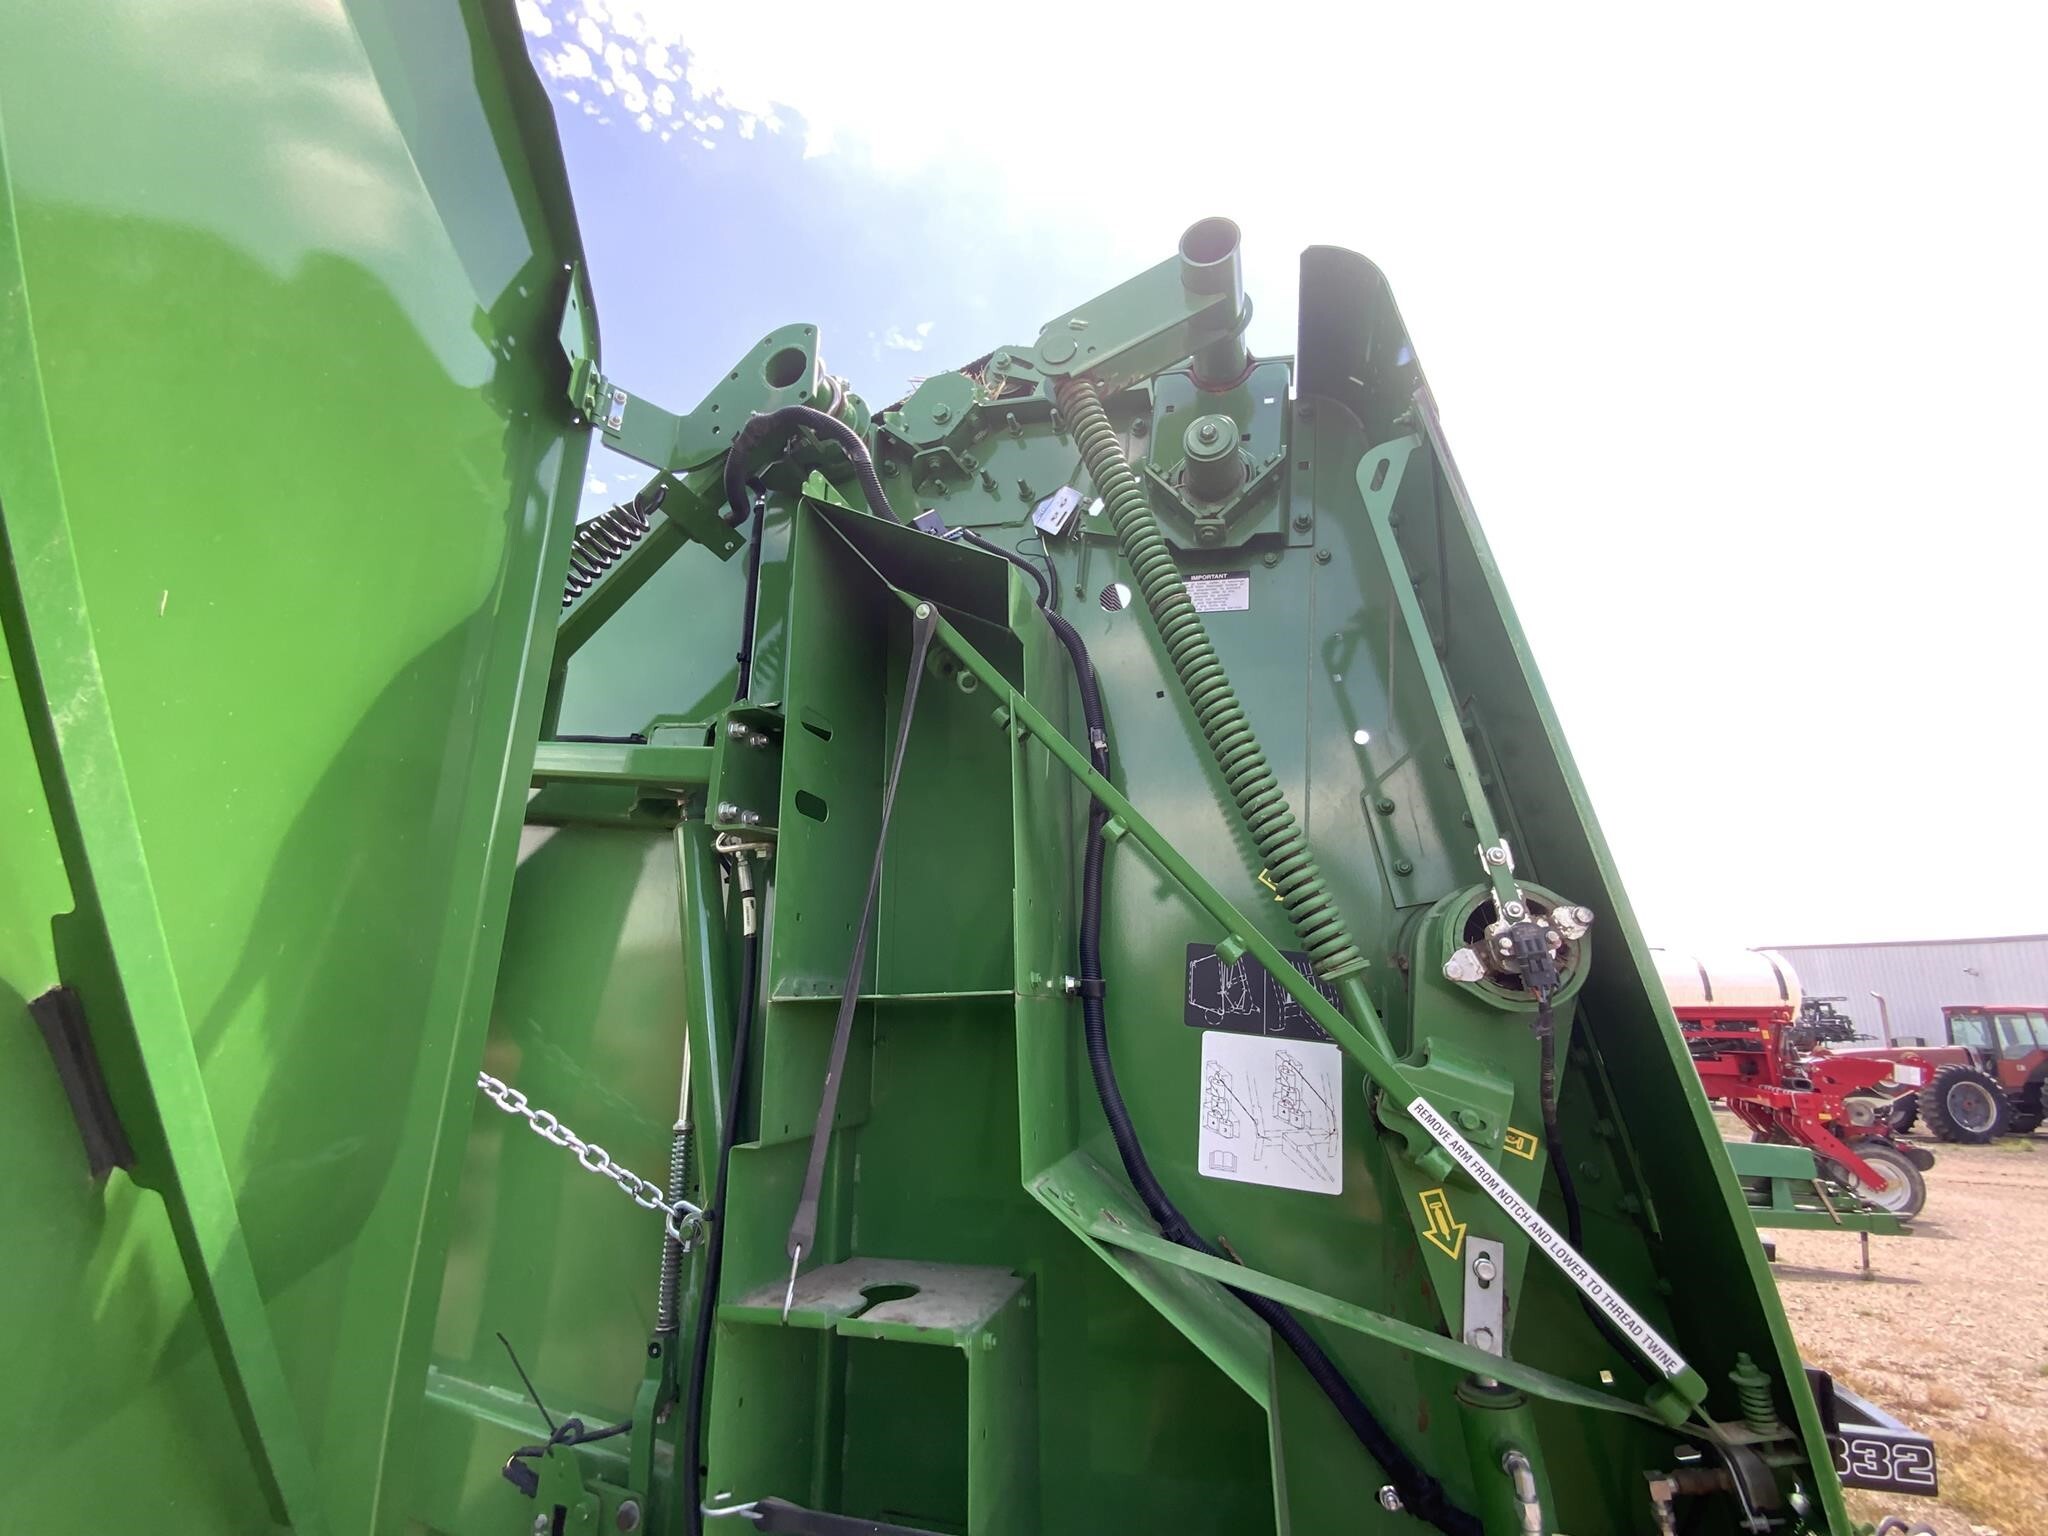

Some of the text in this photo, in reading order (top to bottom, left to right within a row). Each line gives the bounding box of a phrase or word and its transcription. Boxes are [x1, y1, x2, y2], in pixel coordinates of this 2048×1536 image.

[1414, 1103, 1678, 1371] REMOVE ARM FROM NOTCH AND LOWER TO THREAD TWINE
